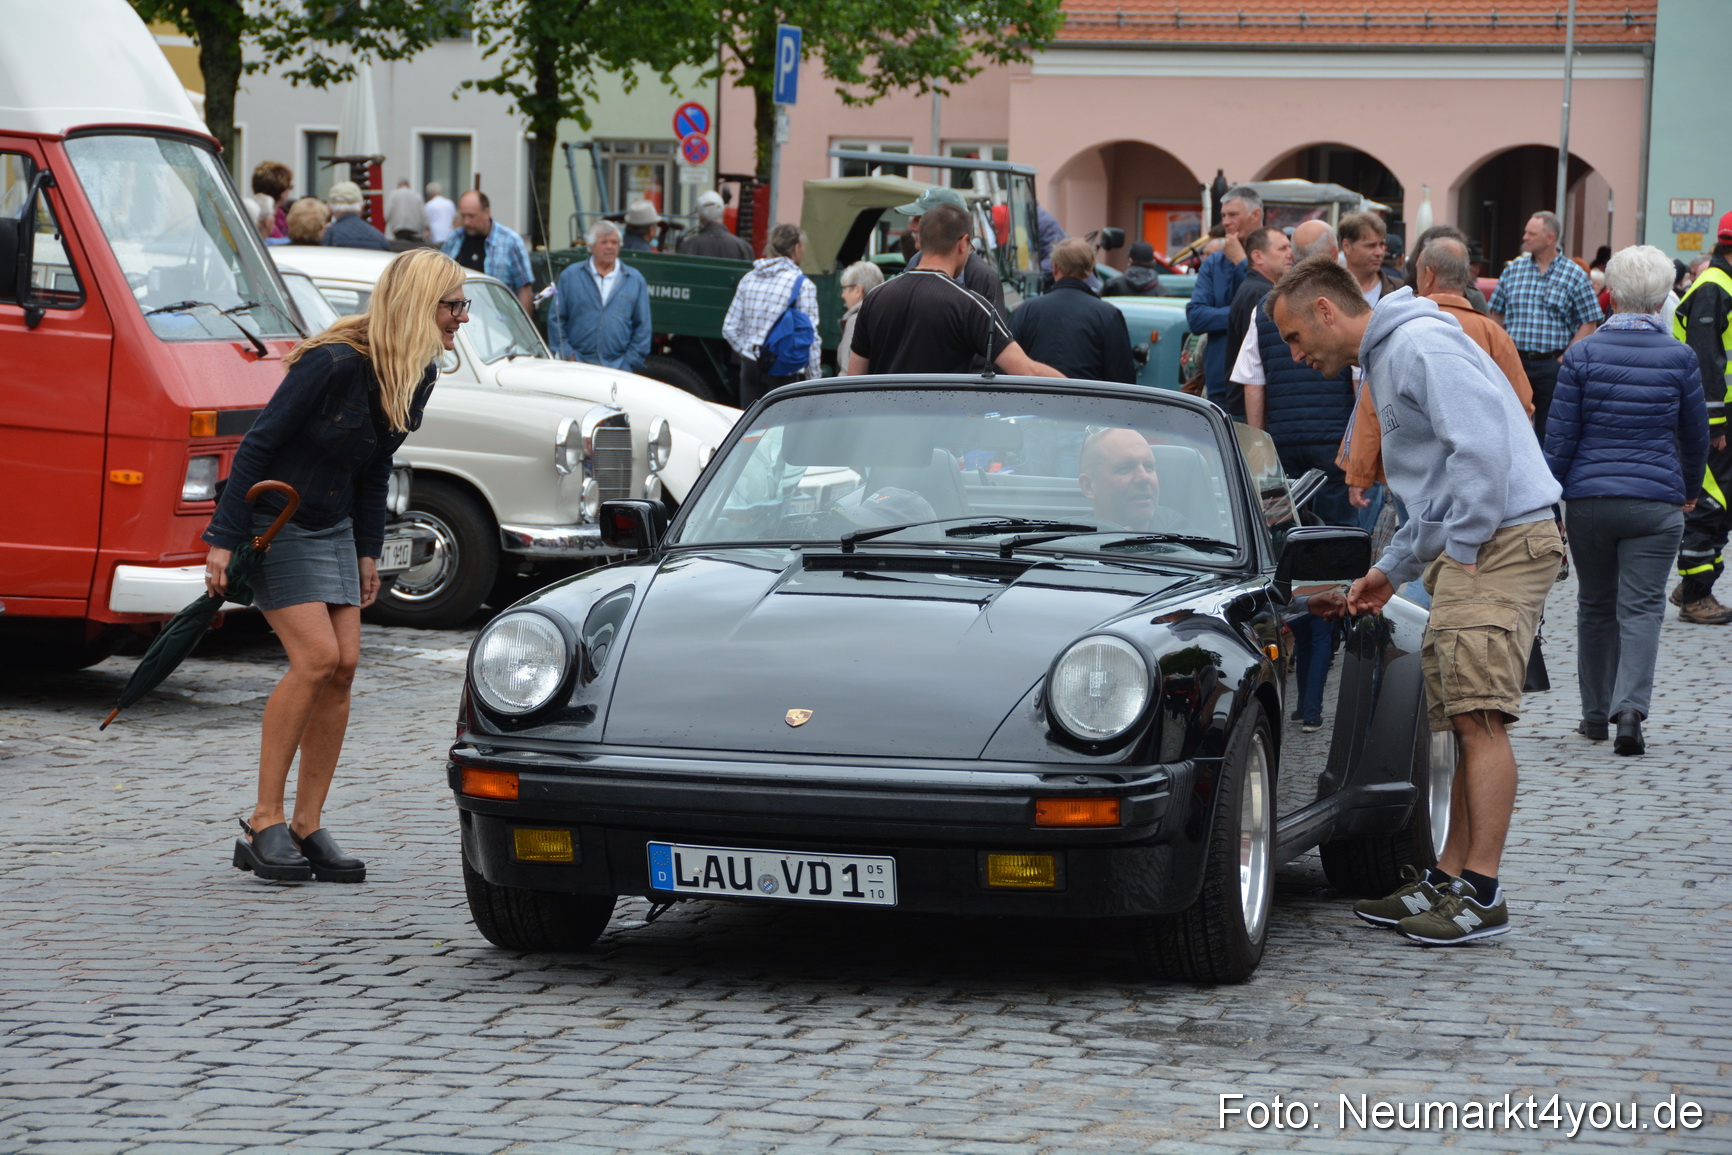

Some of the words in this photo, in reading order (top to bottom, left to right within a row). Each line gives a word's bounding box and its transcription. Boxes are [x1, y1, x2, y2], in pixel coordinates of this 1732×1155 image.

[779, 36, 795, 94] P
[647, 284, 690, 299] NIMOG
[658, 871, 667, 881] D
[674, 852, 753, 891] LAU
[867, 864, 884, 875] 05
[869, 889, 885, 899] 10
[1400, 891, 1433, 915] N
[1453, 908, 1483, 934] N
